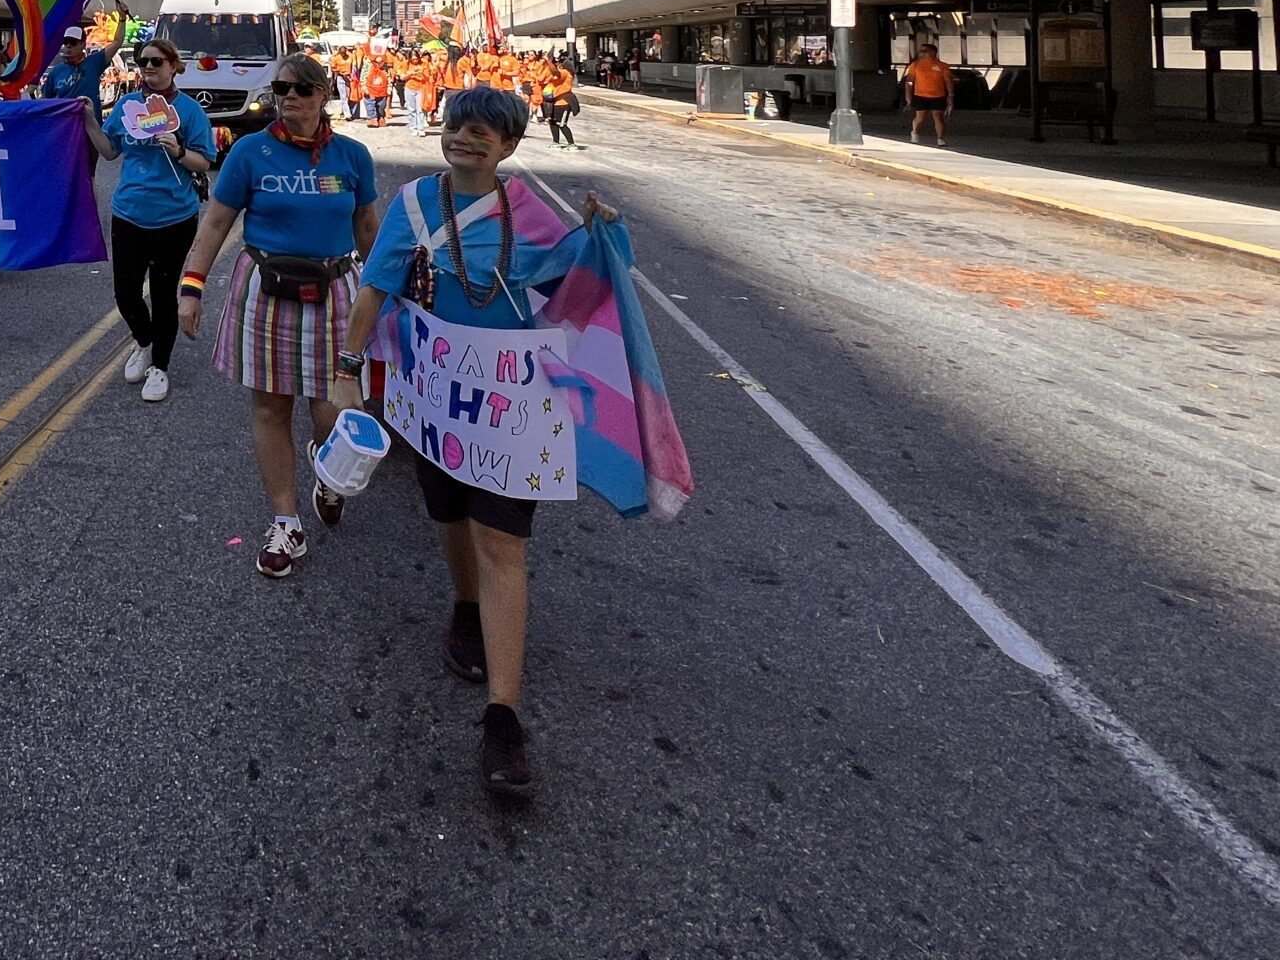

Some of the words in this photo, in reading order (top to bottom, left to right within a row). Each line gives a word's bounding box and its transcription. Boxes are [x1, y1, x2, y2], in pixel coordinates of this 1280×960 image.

[261, 169, 320, 194] avlf
[415, 315, 535, 386] TRANS
[421, 416, 511, 491] NOW
